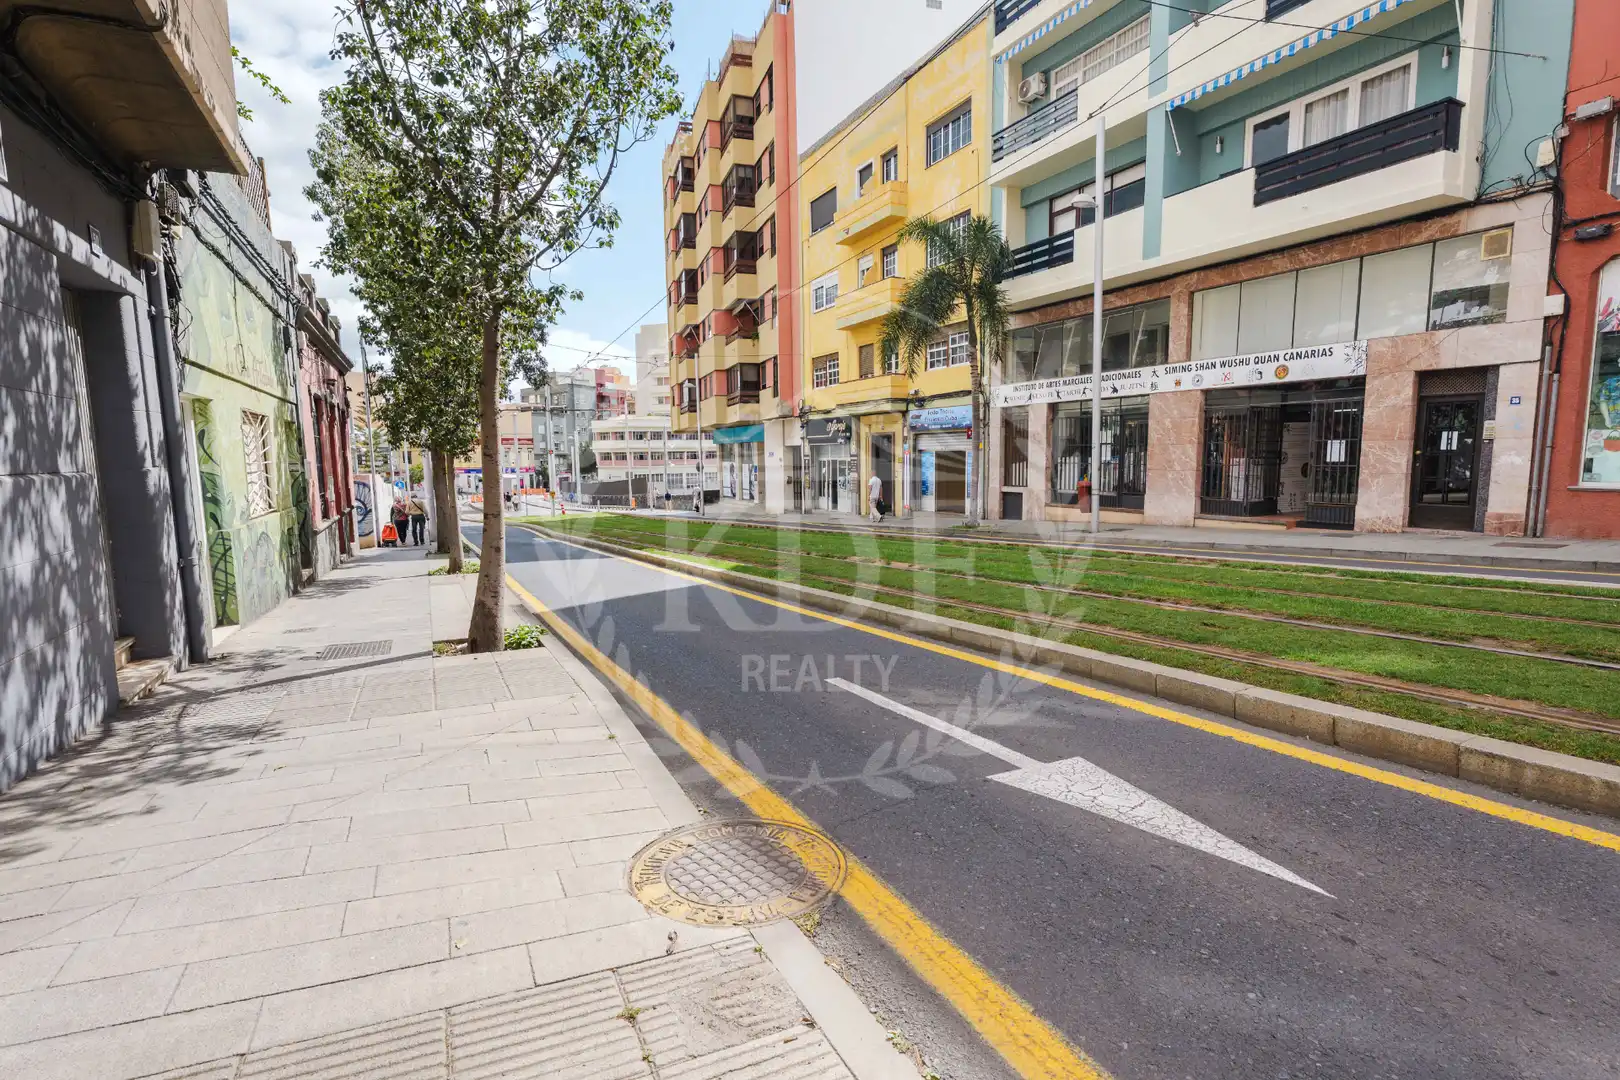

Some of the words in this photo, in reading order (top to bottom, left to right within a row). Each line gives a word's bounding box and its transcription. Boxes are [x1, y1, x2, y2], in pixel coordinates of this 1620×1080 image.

[1164, 363, 1193, 375] SIMING
[1194, 360, 1217, 372] SHAN
[1219, 357, 1251, 369] WUSHU
[1253, 353, 1280, 365] QUAN
[1283, 347, 1334, 362] CANARIAS
[1012, 383, 1037, 393] INSTITUTO
[1045, 380, 1061, 388] ARTES
[1062, 376, 1093, 387] MARCIALES
[1100, 370, 1142, 382] ADICIONALES
